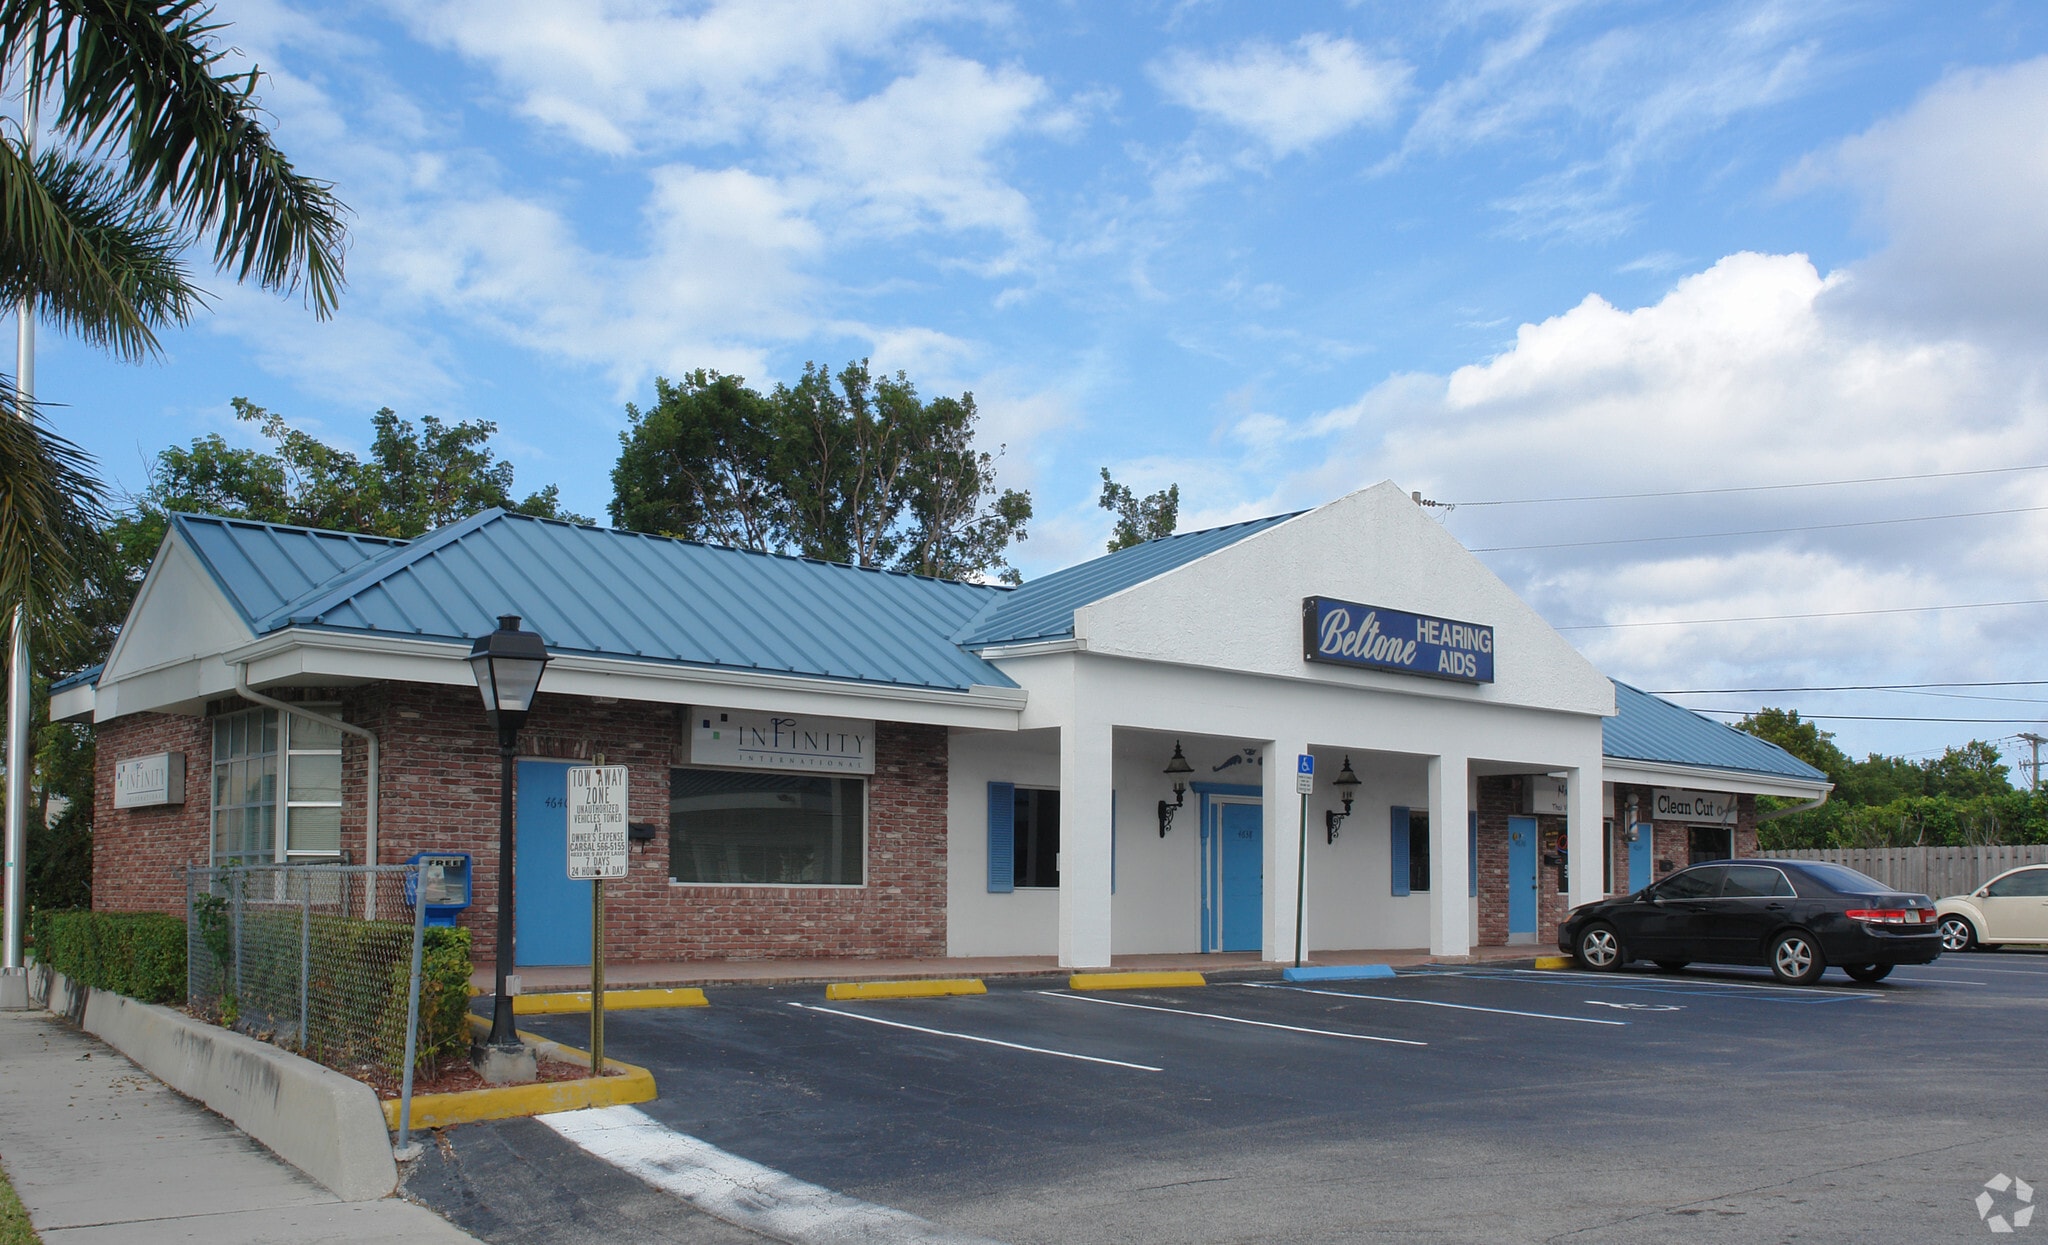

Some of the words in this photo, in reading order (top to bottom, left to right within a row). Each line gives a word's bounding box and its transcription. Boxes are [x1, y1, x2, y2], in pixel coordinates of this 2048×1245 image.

[1319, 607, 1417, 666] Beltone
[1416, 618, 1492, 653] HEARING
[1437, 649, 1477, 678] AIDS
[739, 717, 865, 754] INFINITY
[739, 754, 862, 769] INTERNATIONAL
[126, 762, 165, 791] INFINITY
[572, 769, 591, 787] TOW
[597, 768, 624, 786] AWAY
[586, 786, 610, 804] ZONE
[576, 804, 619, 814] UNAUTHORIZED
[1657, 795, 1691, 815] Clean
[1695, 798, 1714, 817] Cut
[573, 813, 600, 824] VEHICLES
[603, 813, 622, 823] TOWED
[593, 823, 602, 833] AT
[571, 833, 597, 843] OWNER'S
[598, 832, 624, 842] EXPENSE
[570, 842, 595, 852] CARSAL
[596, 842, 625, 851] 566-5155
[585, 857, 590, 866] 7
[593, 856, 610, 866] DAYS
[571, 867, 579, 876] 24
[604, 866, 609, 875] A
[612, 866, 624, 875] DAY
